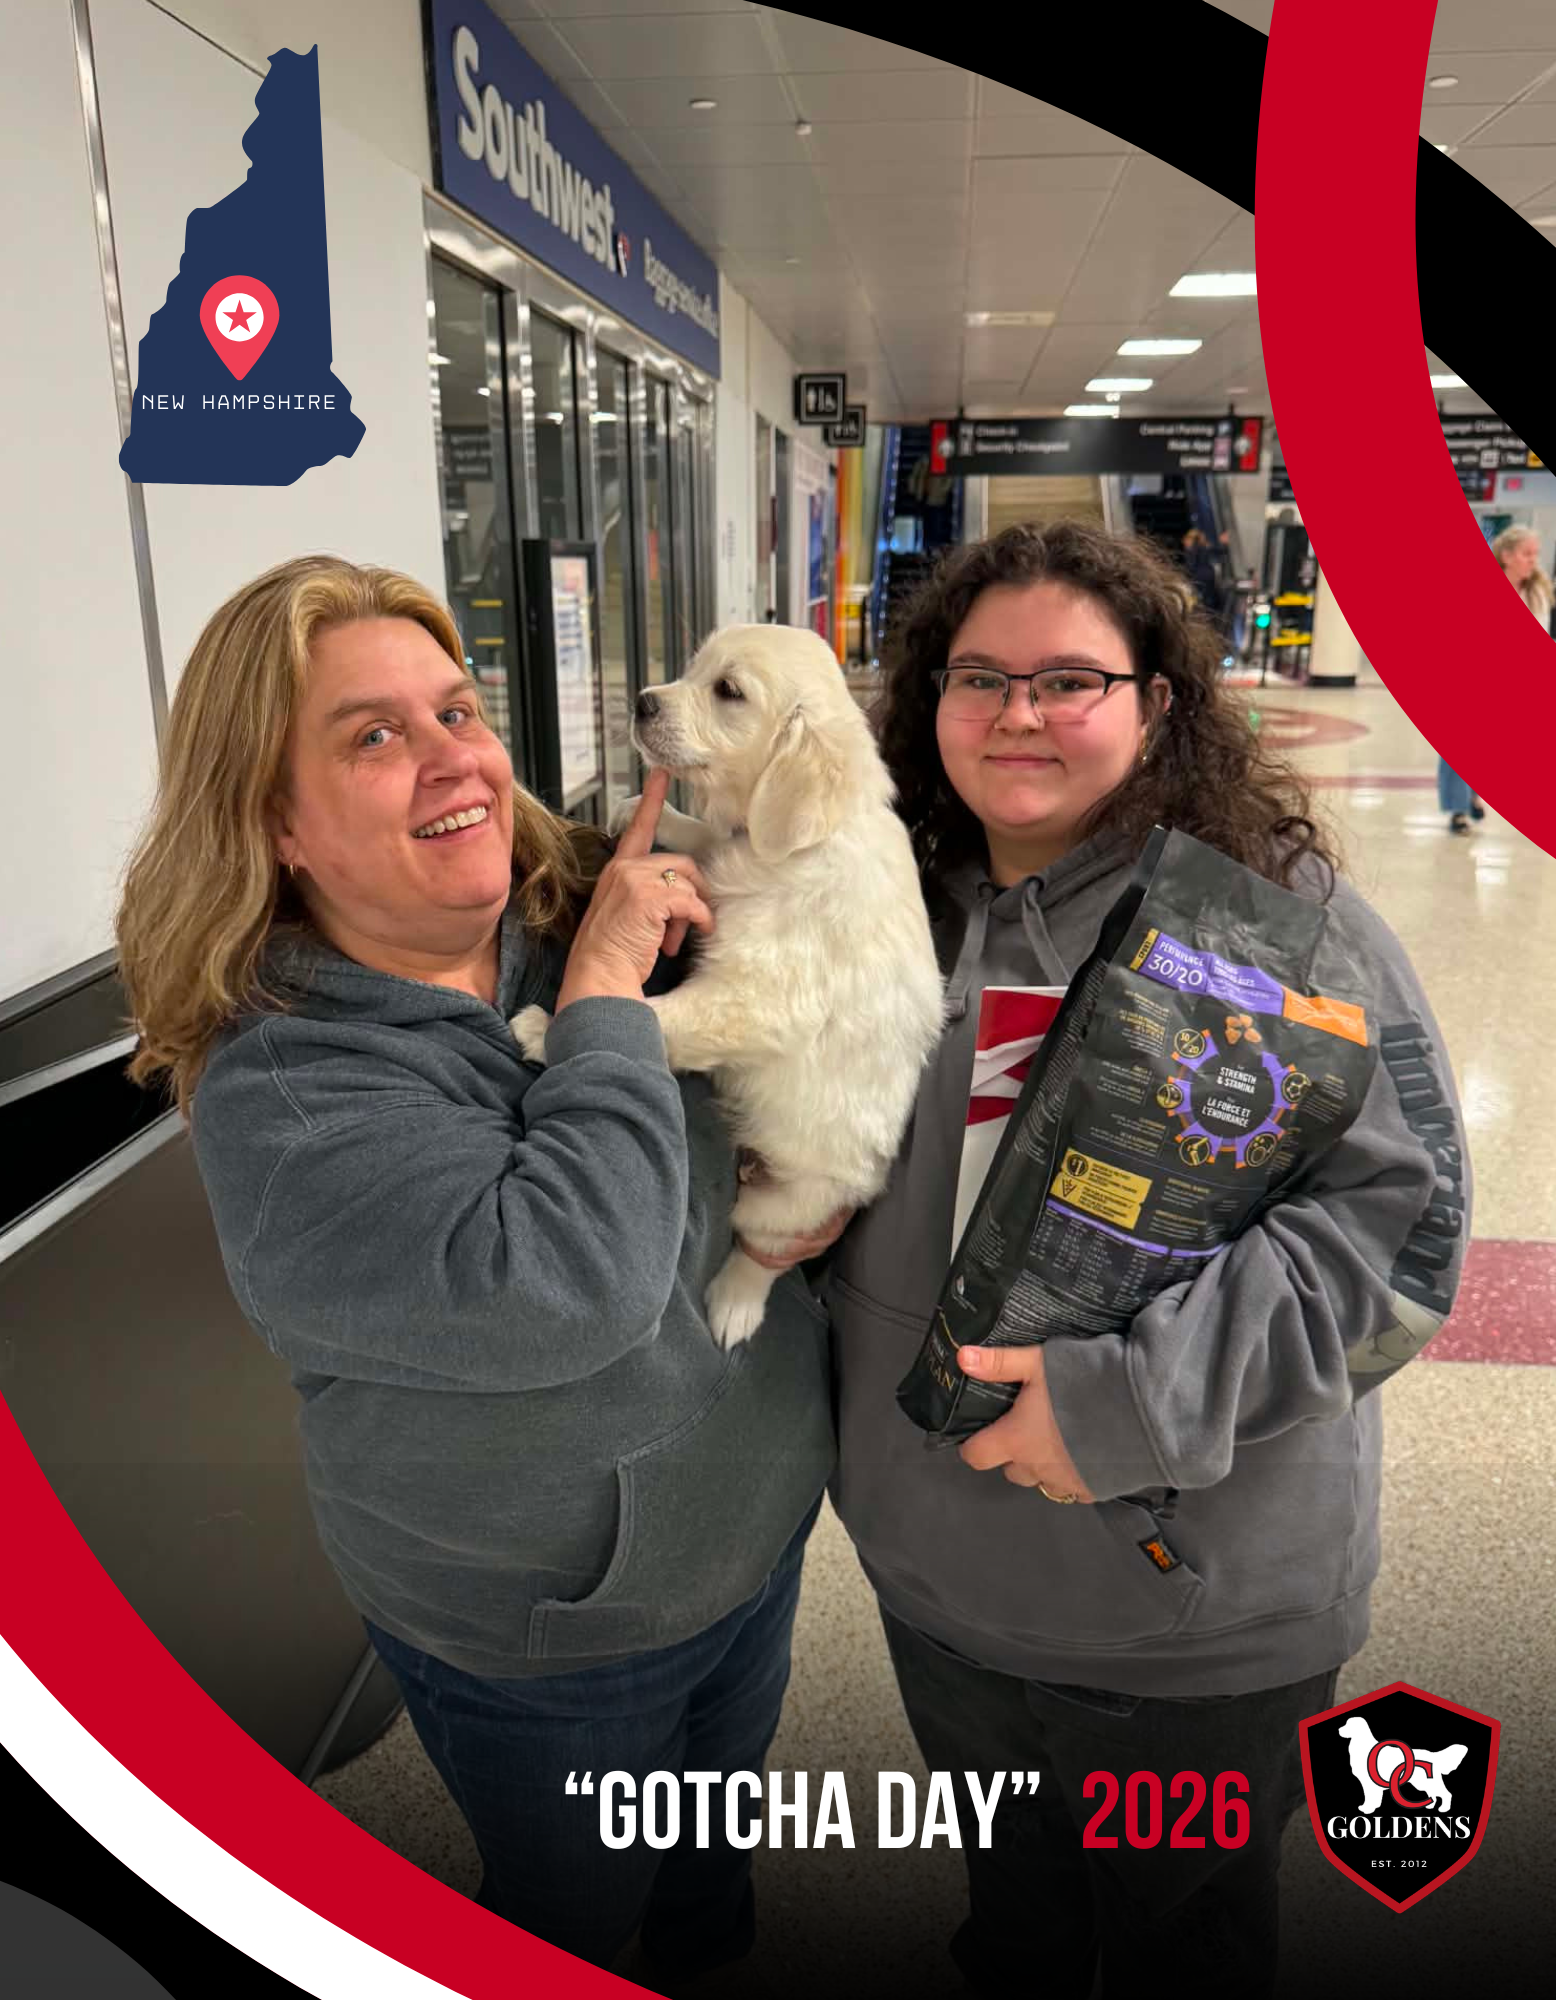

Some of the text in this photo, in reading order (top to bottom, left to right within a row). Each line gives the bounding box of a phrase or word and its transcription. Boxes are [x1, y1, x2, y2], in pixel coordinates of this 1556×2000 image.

[453, 26, 617, 273] Southwest
[975, 440, 1070, 454] Security Checkpoint
[1148, 953, 1203, 986] 30/20
[1216, 1075, 1255, 1094] & STAMINA
[1219, 1066, 1257, 1085] STRENGTH
[1201, 1106, 1250, 1128] L'ENDURANCE
[1206, 1097, 1251, 1118] LA FORCE ET
